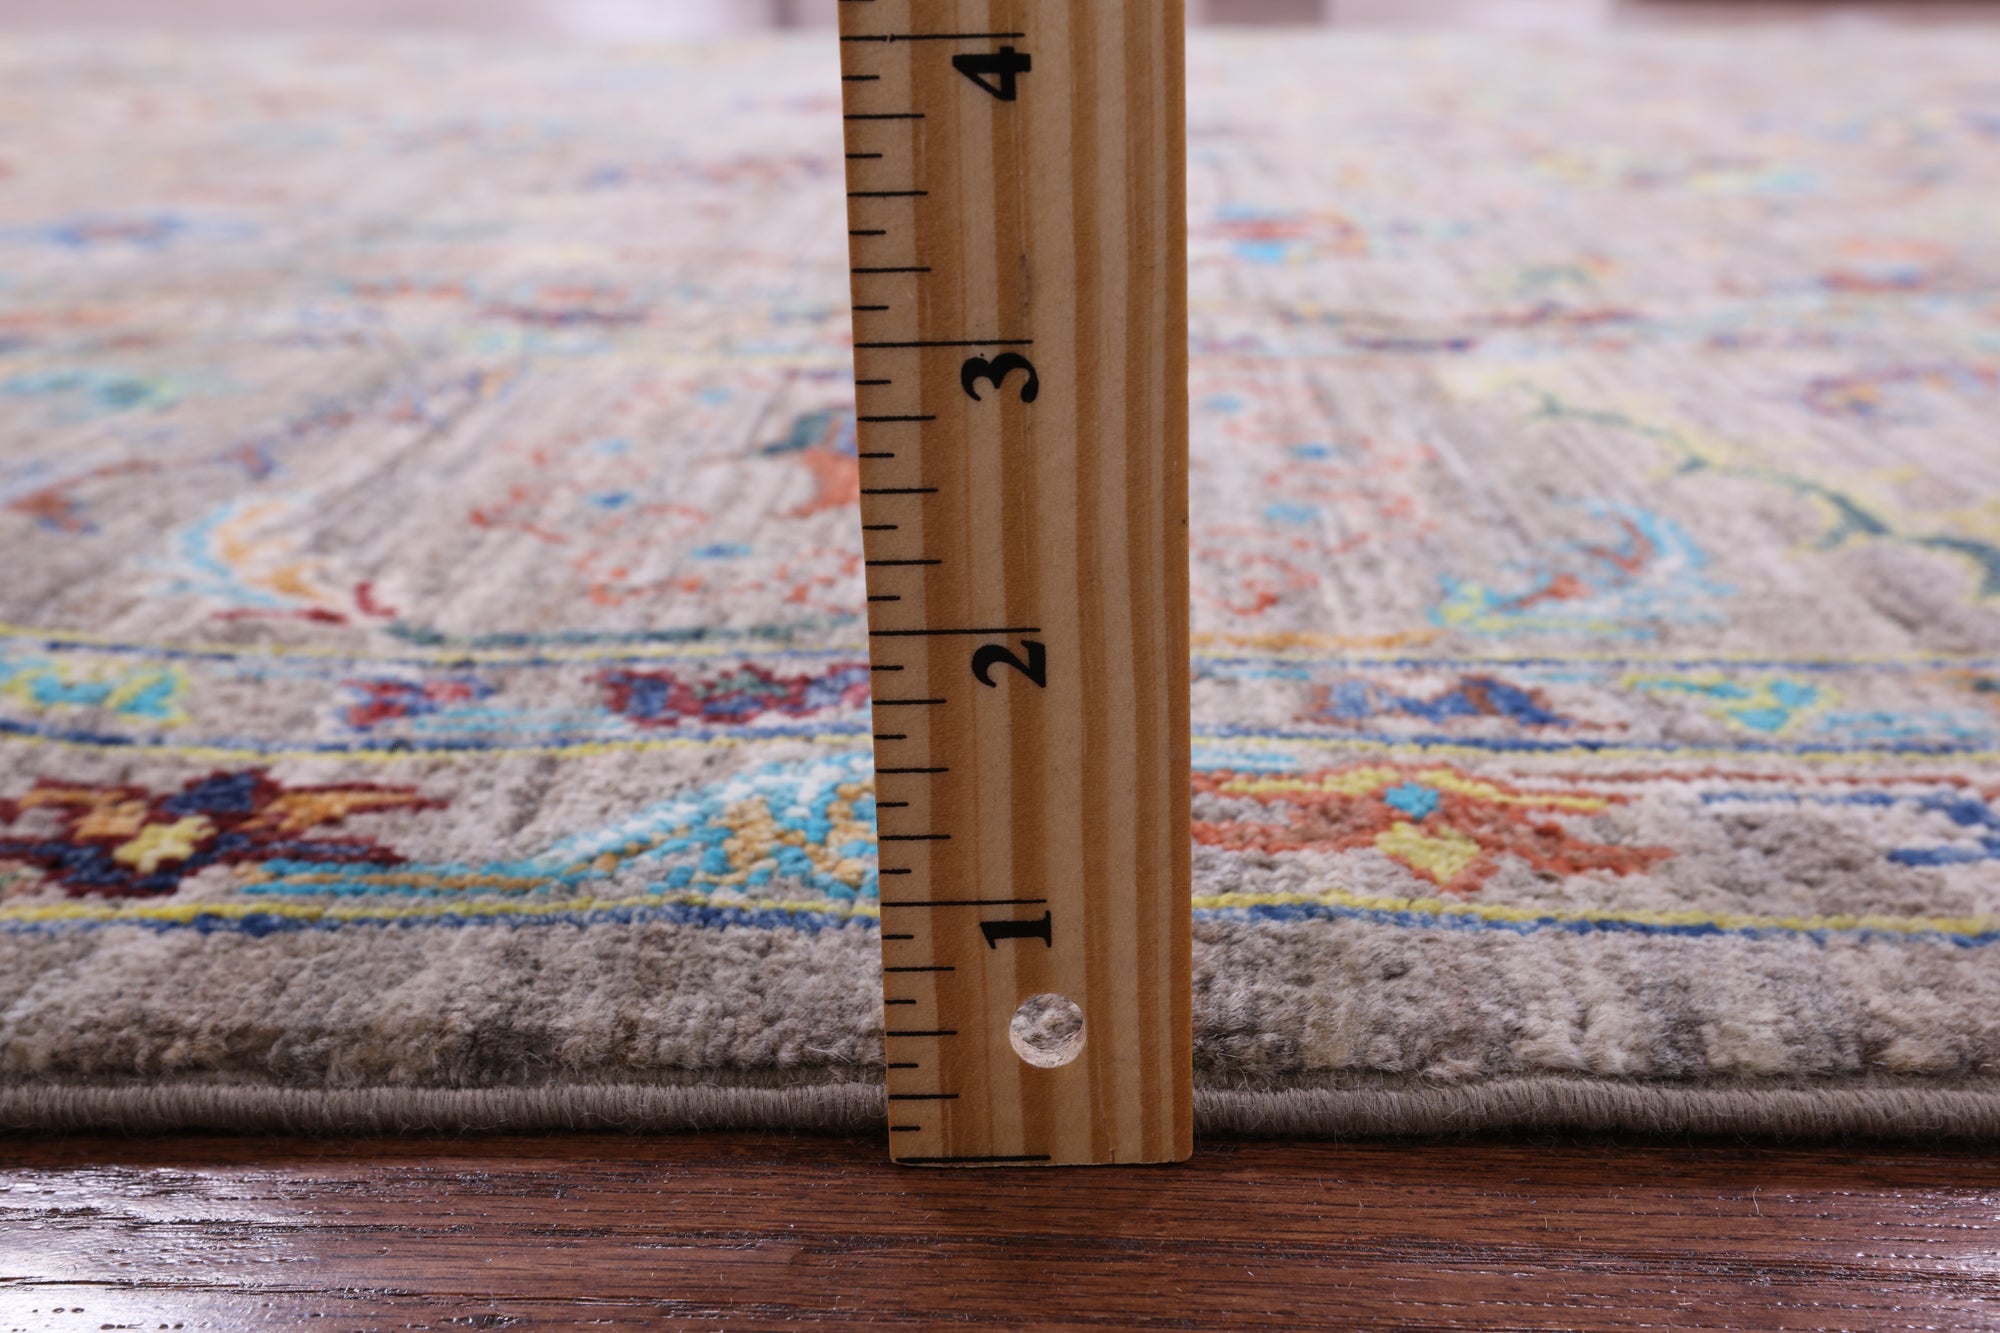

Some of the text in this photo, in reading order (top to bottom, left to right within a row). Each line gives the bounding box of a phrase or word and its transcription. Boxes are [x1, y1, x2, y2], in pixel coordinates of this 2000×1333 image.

[951, 46, 1032, 101] 4
[960, 352, 1040, 404] 3
[971, 639, 1047, 689] 2
[979, 909, 1053, 950] 1
